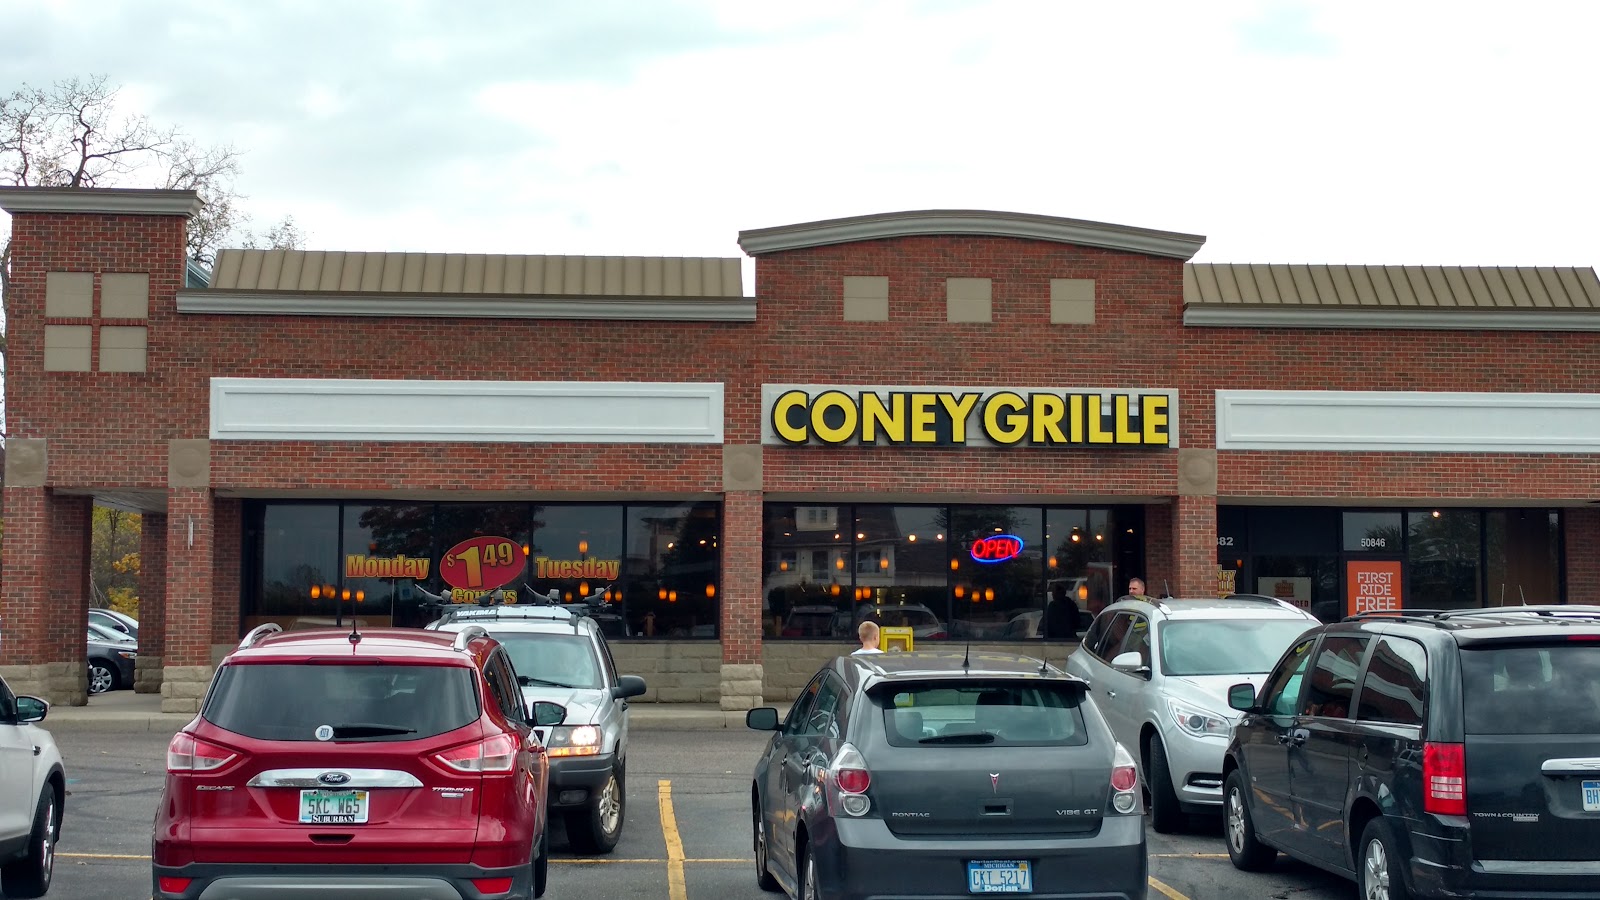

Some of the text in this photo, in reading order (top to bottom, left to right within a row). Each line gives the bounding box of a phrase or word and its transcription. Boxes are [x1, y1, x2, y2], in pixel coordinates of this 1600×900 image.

[772, 389, 1170, 445] CONEY GRILLE
[1217, 536, 1234, 546] 82
[1361, 538, 1386, 547] 50846
[972, 539, 1020, 559] OPEN
[346, 555, 430, 580] Monday
[536, 557, 620, 580] Tuesday
[1357, 571, 1394, 583] FIRST
[1360, 584, 1391, 597] RIDE
[1355, 597, 1396, 612] FREE
[325, 773, 343, 782] Ford
[338, 798, 360, 814] W65
[313, 814, 355, 823] SUBURBAN
[1000, 869, 1026, 885] 5217
[984, 884, 1018, 893] Dorian
